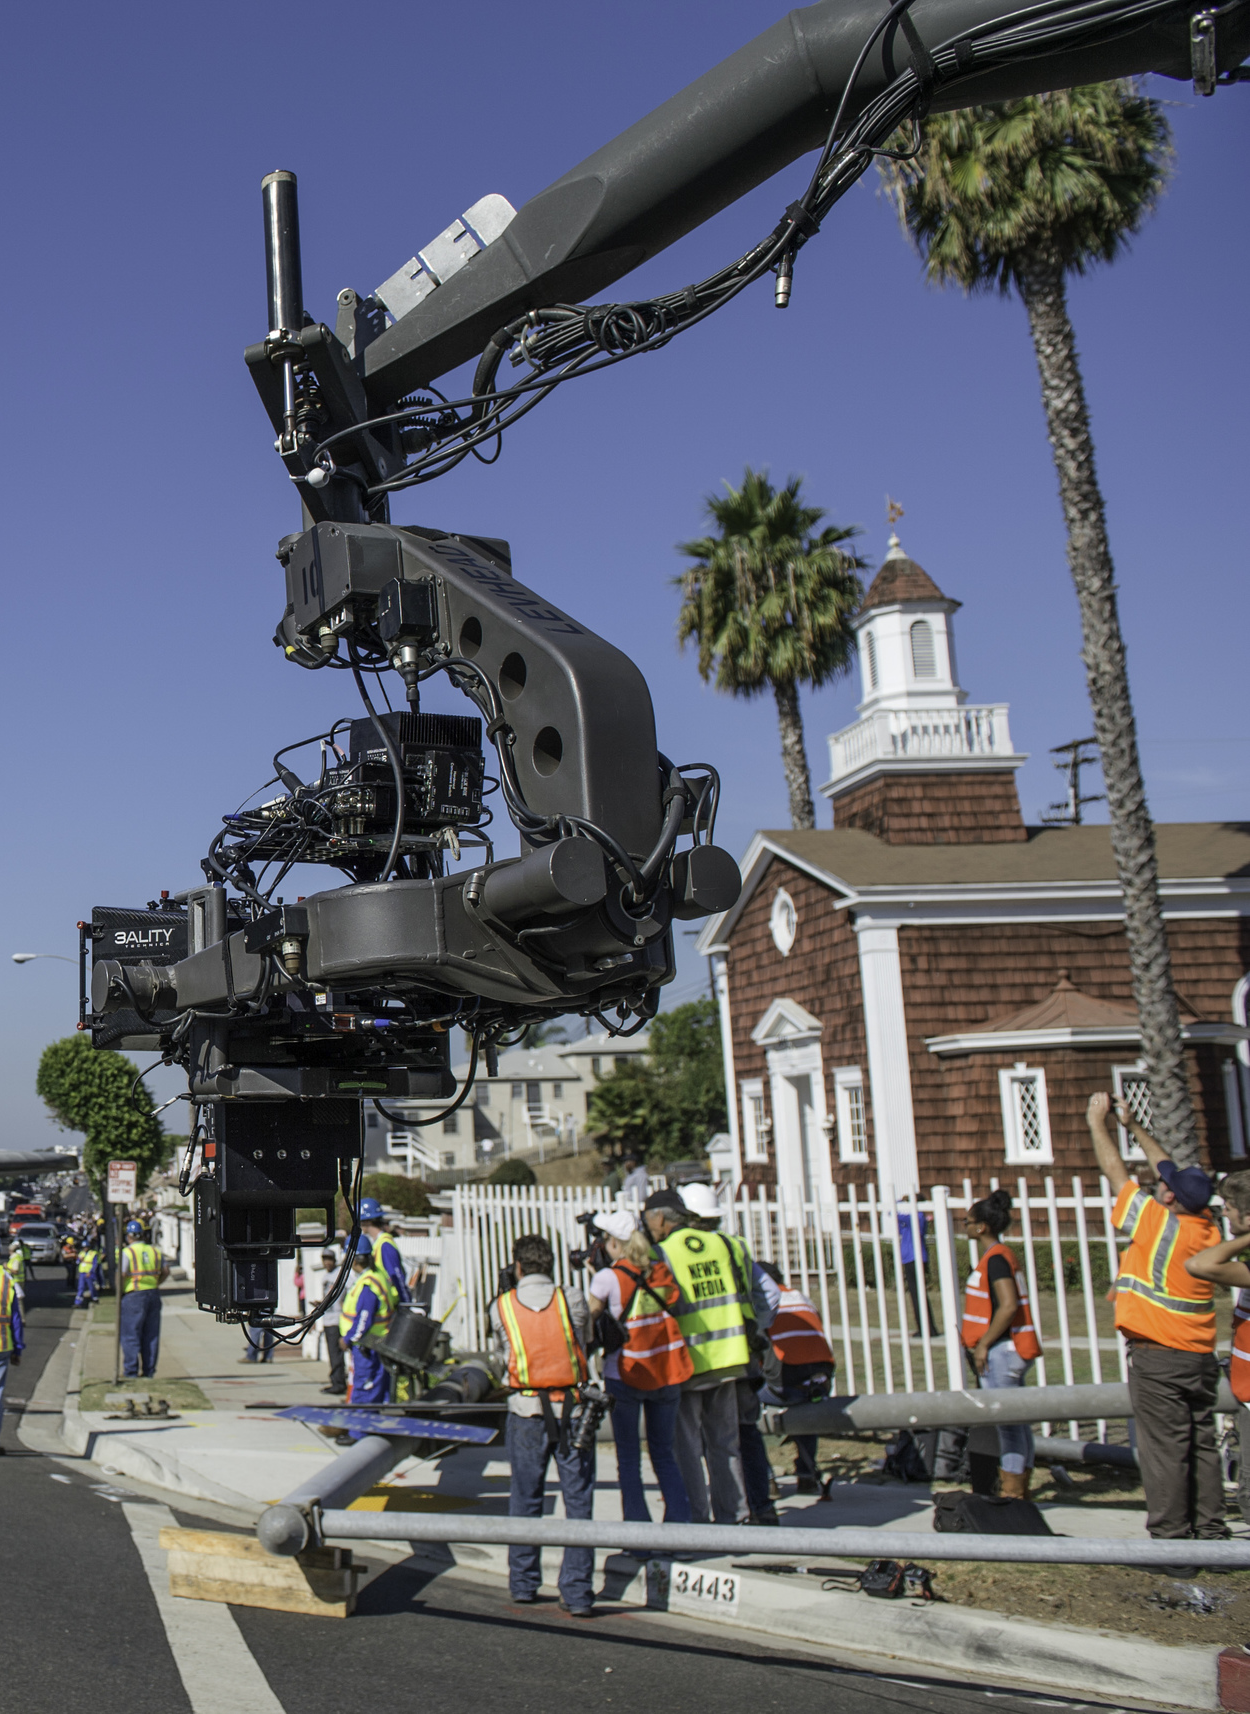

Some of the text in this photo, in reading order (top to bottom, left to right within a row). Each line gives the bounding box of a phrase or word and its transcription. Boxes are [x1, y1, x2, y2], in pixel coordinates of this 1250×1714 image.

[114, 928, 173, 945] 3ALITY
[688, 1261, 720, 1279] NEWS
[692, 1279, 727, 1299] MEDIA
[676, 1570, 735, 1602] 3443
